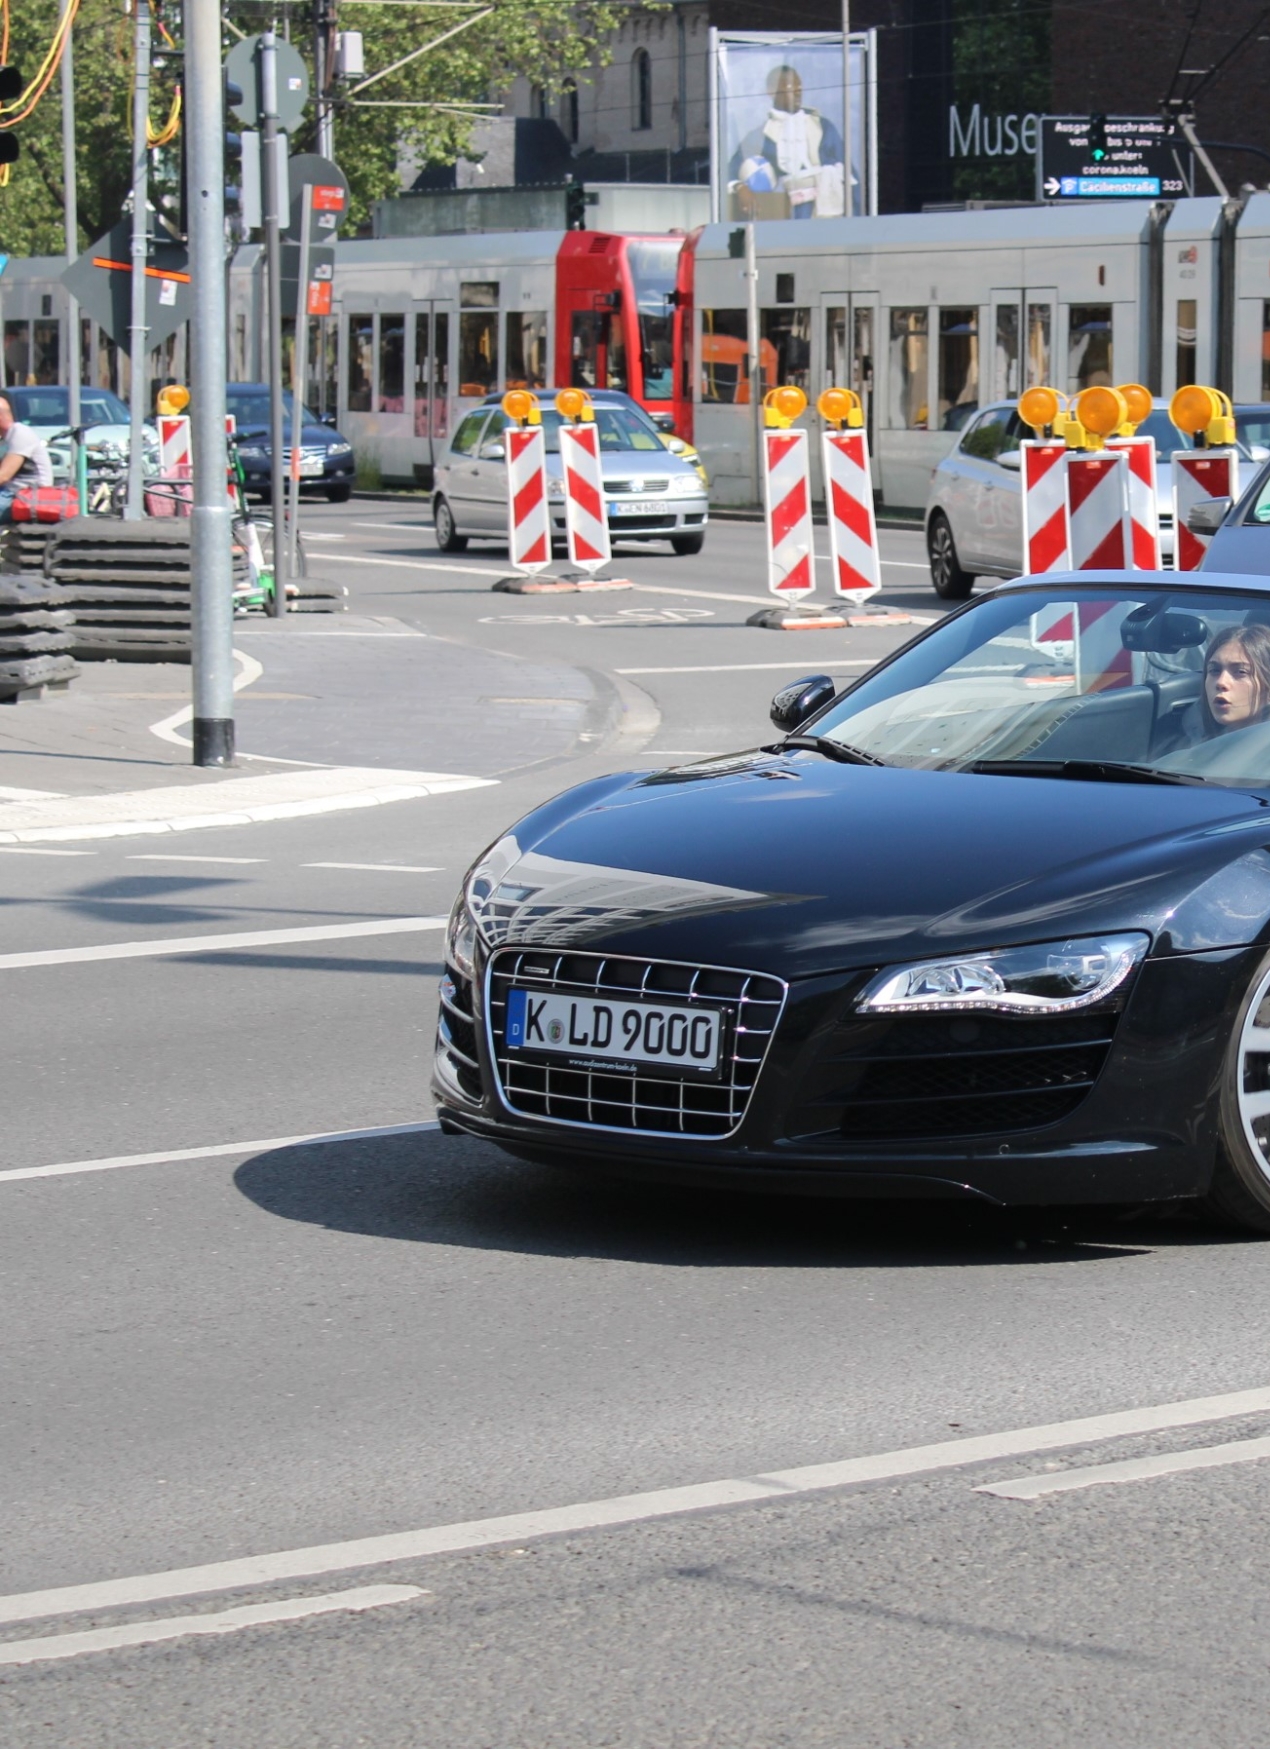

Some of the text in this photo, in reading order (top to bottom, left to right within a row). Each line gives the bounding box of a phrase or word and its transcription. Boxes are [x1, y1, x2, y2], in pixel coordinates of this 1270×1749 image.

[1162, 180, 1183, 191] 323
[526, 998, 548, 1042] K
[569, 1003, 613, 1049] LD
[623, 1009, 712, 1060] 9000
